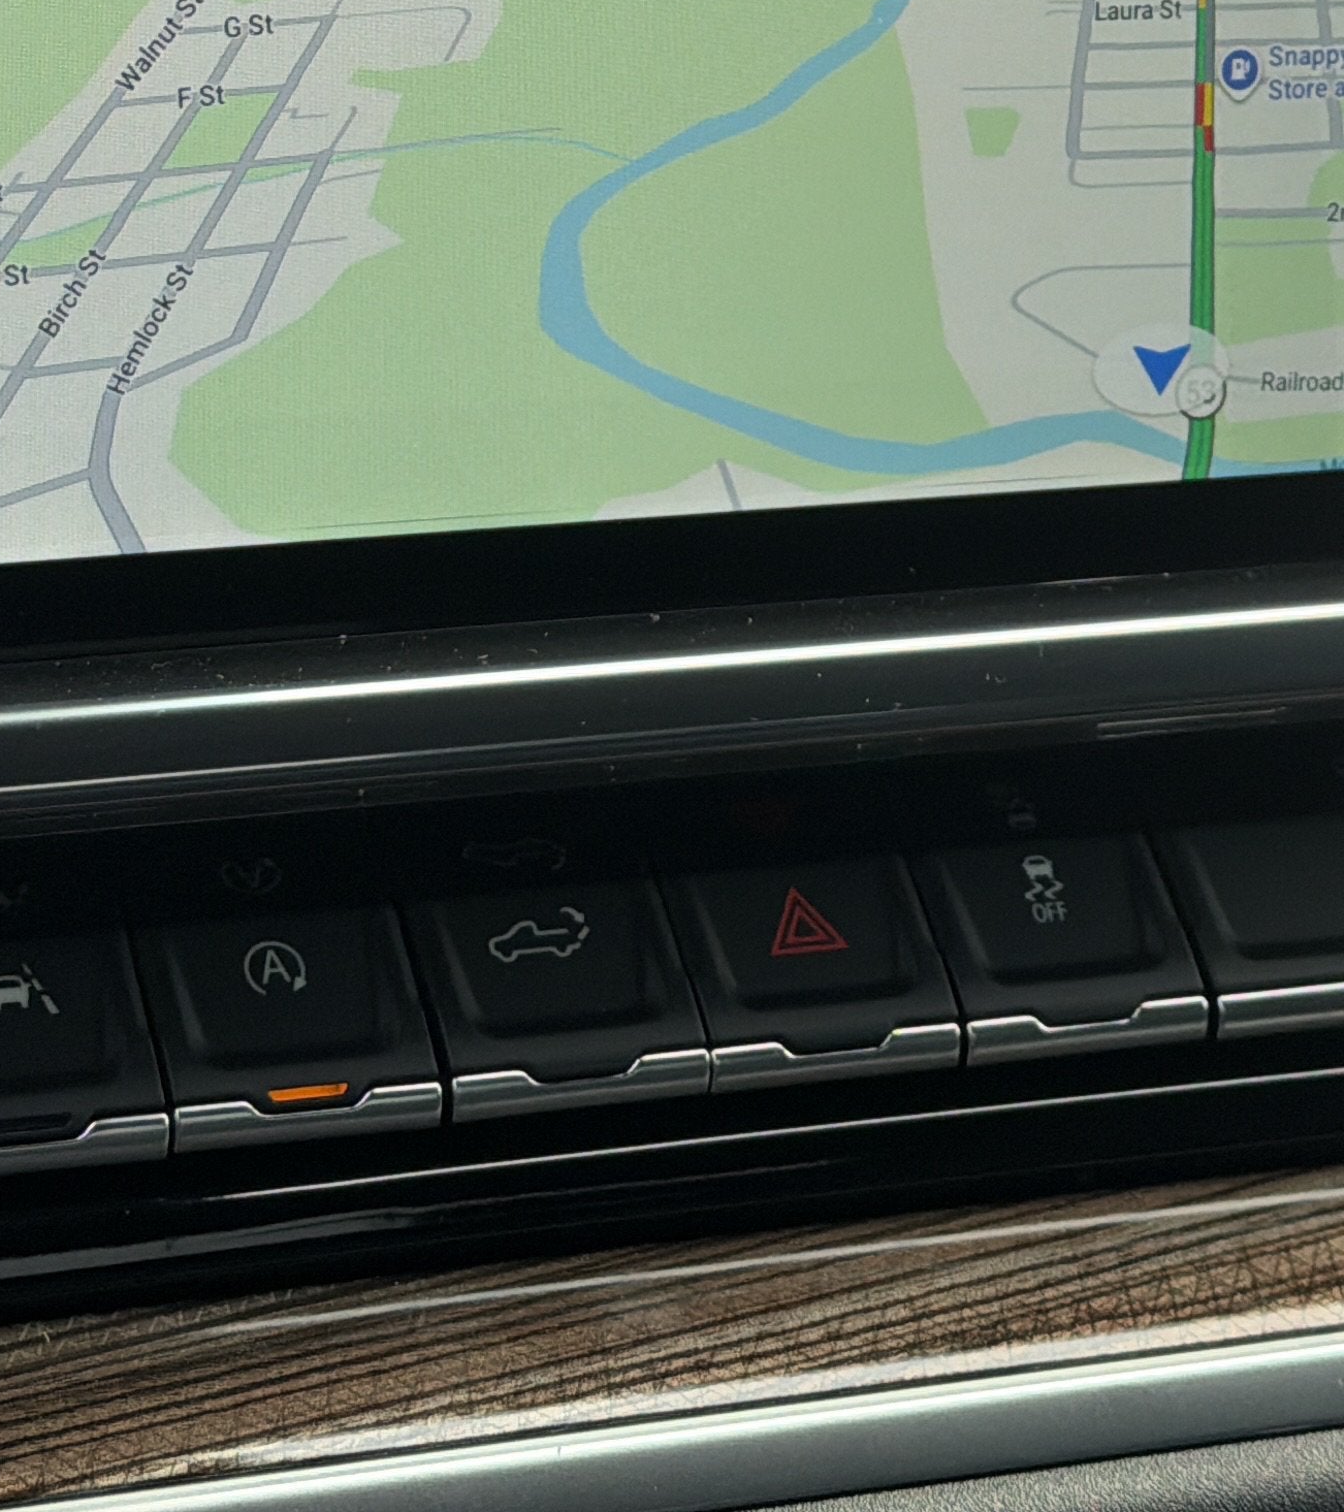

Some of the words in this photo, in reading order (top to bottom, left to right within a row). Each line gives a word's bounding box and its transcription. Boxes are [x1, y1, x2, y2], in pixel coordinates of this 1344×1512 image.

[1094, 1, 1154, 22] Laura
[1159, 0, 1182, 20] St
[223, 16, 242, 38] G
[248, 14, 275, 36] St
[115, 15, 183, 92] Walnut
[177, 87, 192, 108] F
[199, 85, 225, 107] St
[1268, 76, 1330, 101] Store
[4, 264, 30, 286] St
[38, 277, 87, 340] Birch
[78, 249, 106, 281] St
[106, 294, 175, 395] Hemlock
[168, 262, 196, 297] St
[1260, 371, 1344, 392] Railroad
[1031, 901, 1068, 924] OFF
